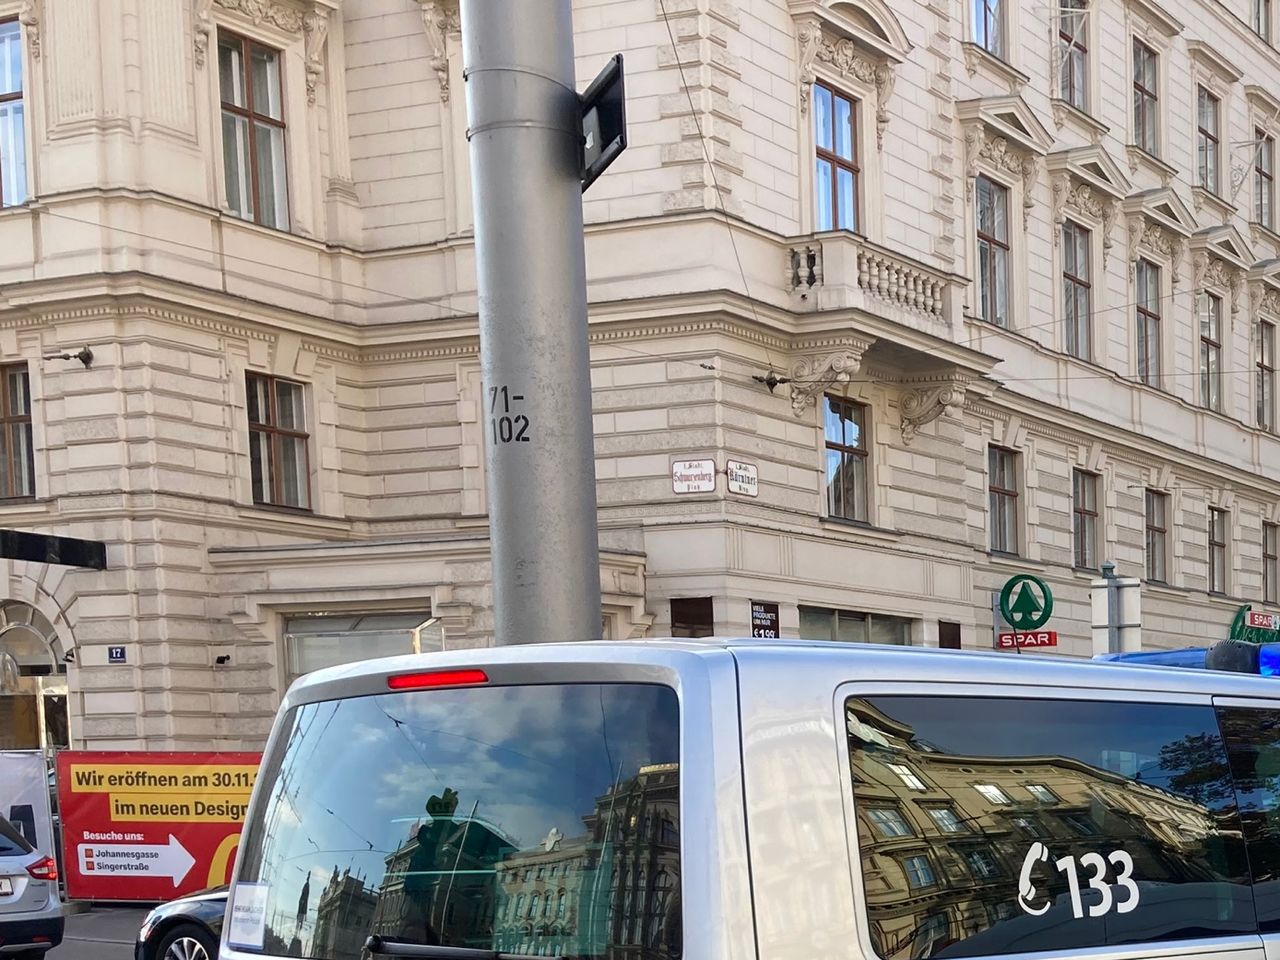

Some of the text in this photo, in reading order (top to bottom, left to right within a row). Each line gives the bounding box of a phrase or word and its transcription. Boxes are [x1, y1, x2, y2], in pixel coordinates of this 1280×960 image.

[491, 415, 530, 444] 102
[1254, 614, 1272, 626] SPAR
[1002, 633, 1049, 646] SPAR
[111, 648, 121, 658] 17
[76, 771, 258, 787] Wir eröffnen am 30.11.
[115, 799, 135, 815] im
[139, 802, 190, 816] neuen
[83, 831, 144, 841] Besuche uns:
[95, 850, 159, 860] Johannesgasse
[97, 862, 149, 872] Singerstraße
[1056, 849, 1140, 918] 133
